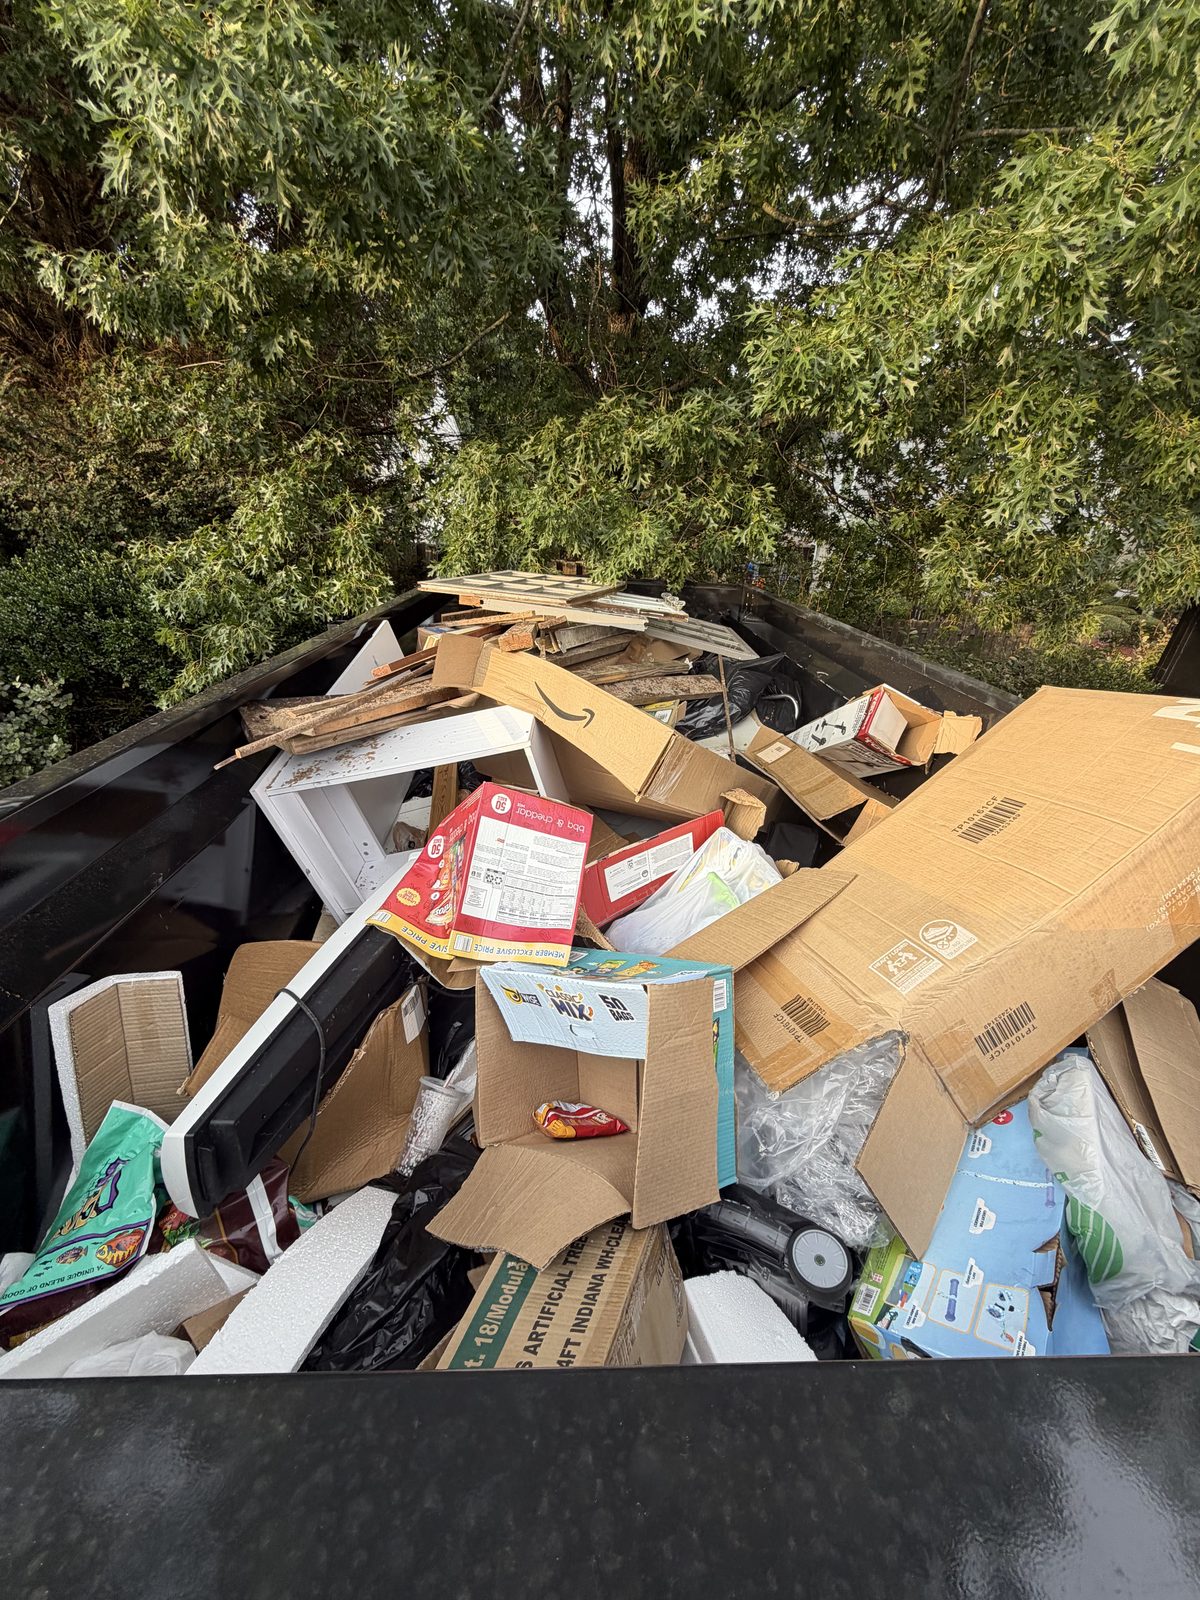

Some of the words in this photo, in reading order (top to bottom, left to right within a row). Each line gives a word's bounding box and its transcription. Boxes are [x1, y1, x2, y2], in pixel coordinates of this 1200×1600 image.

[496, 800, 506, 811] 50
[516, 808, 553, 824] cheddar
[951, 795, 1000, 834] TP10161CF
[556, 818, 564, 827] &
[567, 820, 585, 834] bbq
[431, 844, 441, 854] 50
[401, 926, 428, 945] PRICE
[474, 944, 494, 954] PRICE
[496, 947, 533, 956] EXCLUSIVE
[536, 949, 565, 958] MEMBER
[522, 994, 542, 1006] WISE
[545, 989, 578, 1002] CLASSIC
[599, 994, 627, 1010] 50
[550, 998, 590, 1022] MIX
[610, 1008, 634, 1022] BAGS
[988, 1024, 1038, 1062] TP10161CF
[40, 1275, 65, 1288] BLEND
[68, 1268, 94, 1282] UNIQUE
[523, 1270, 574, 1356] ARTIFICIAL
[556, 1338, 582, 1368] 4FT
[570, 1271, 606, 1334] INDIANA
